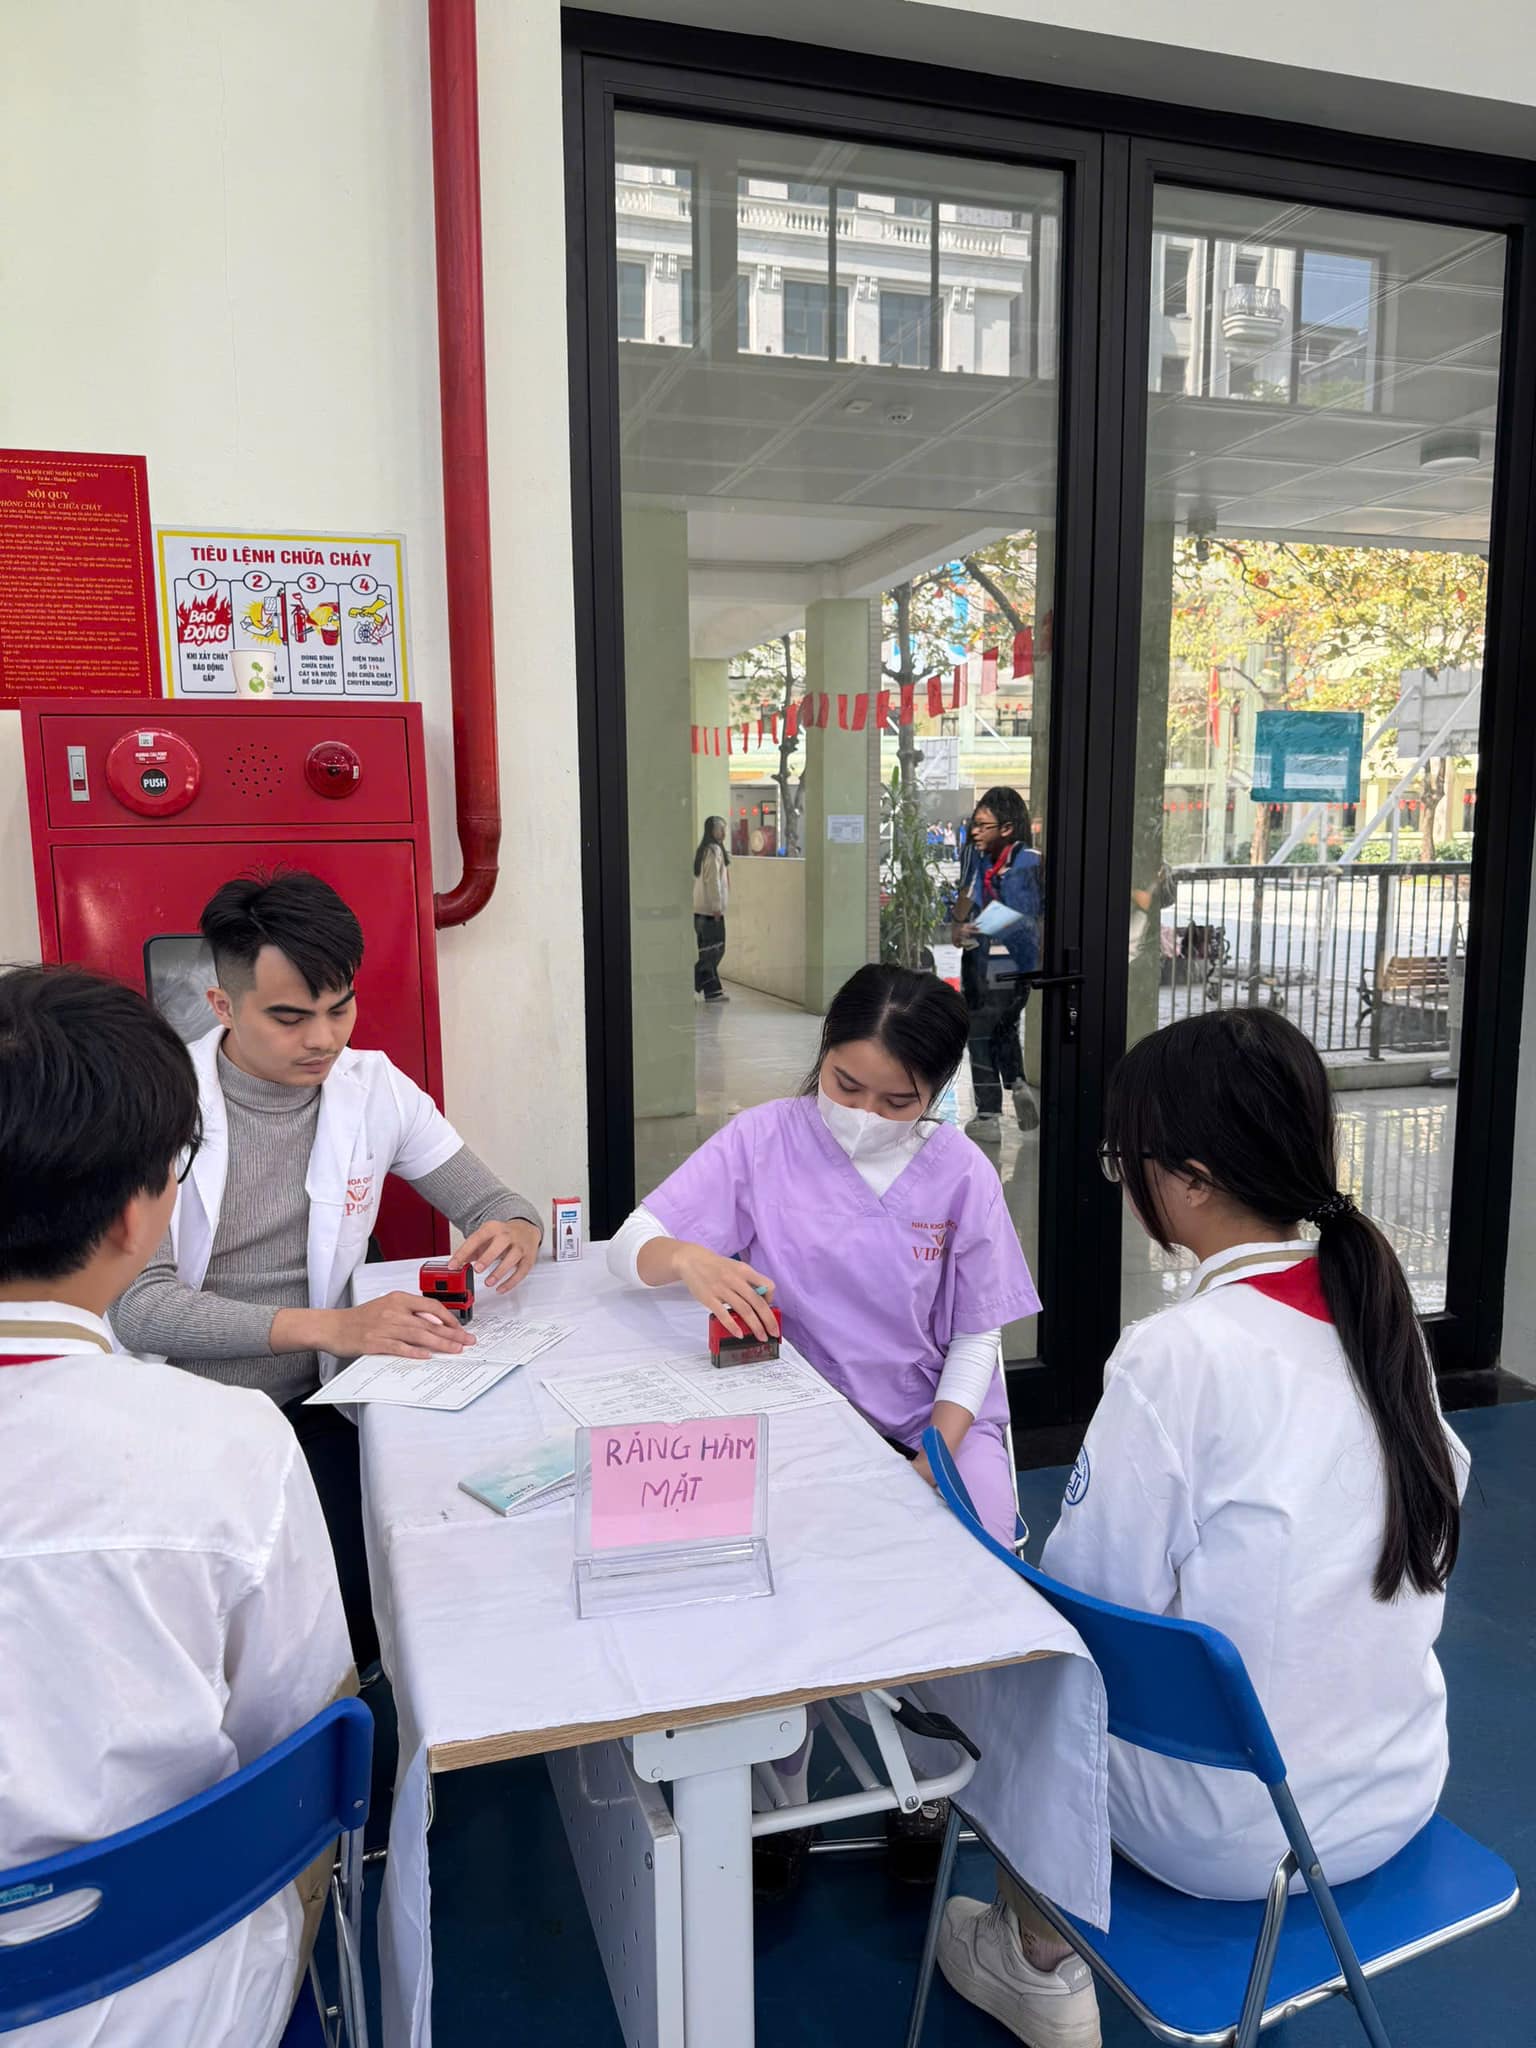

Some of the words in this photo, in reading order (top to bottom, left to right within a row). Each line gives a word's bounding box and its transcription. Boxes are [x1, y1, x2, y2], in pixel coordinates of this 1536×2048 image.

[27, 488, 45, 499] NỘI
[48, 490, 69, 500] QUY
[191, 545, 227, 562] TIÊU
[233, 546, 275, 565] LỆNH
[281, 548, 324, 565] CHỮA
[330, 550, 371, 567] CHÁY
[198, 573, 206, 586] 1
[252, 575, 263, 588] 2
[306, 577, 316, 590] 3
[360, 578, 370, 591] 4
[189, 608, 216, 623] BÁO
[184, 623, 227, 643] ĐỘNG
[144, 778, 166, 788] PUSH
[912, 1246, 940, 1261] VIP
[606, 1432, 691, 1467] RĂNG
[642, 1472, 703, 1512] MẶT
